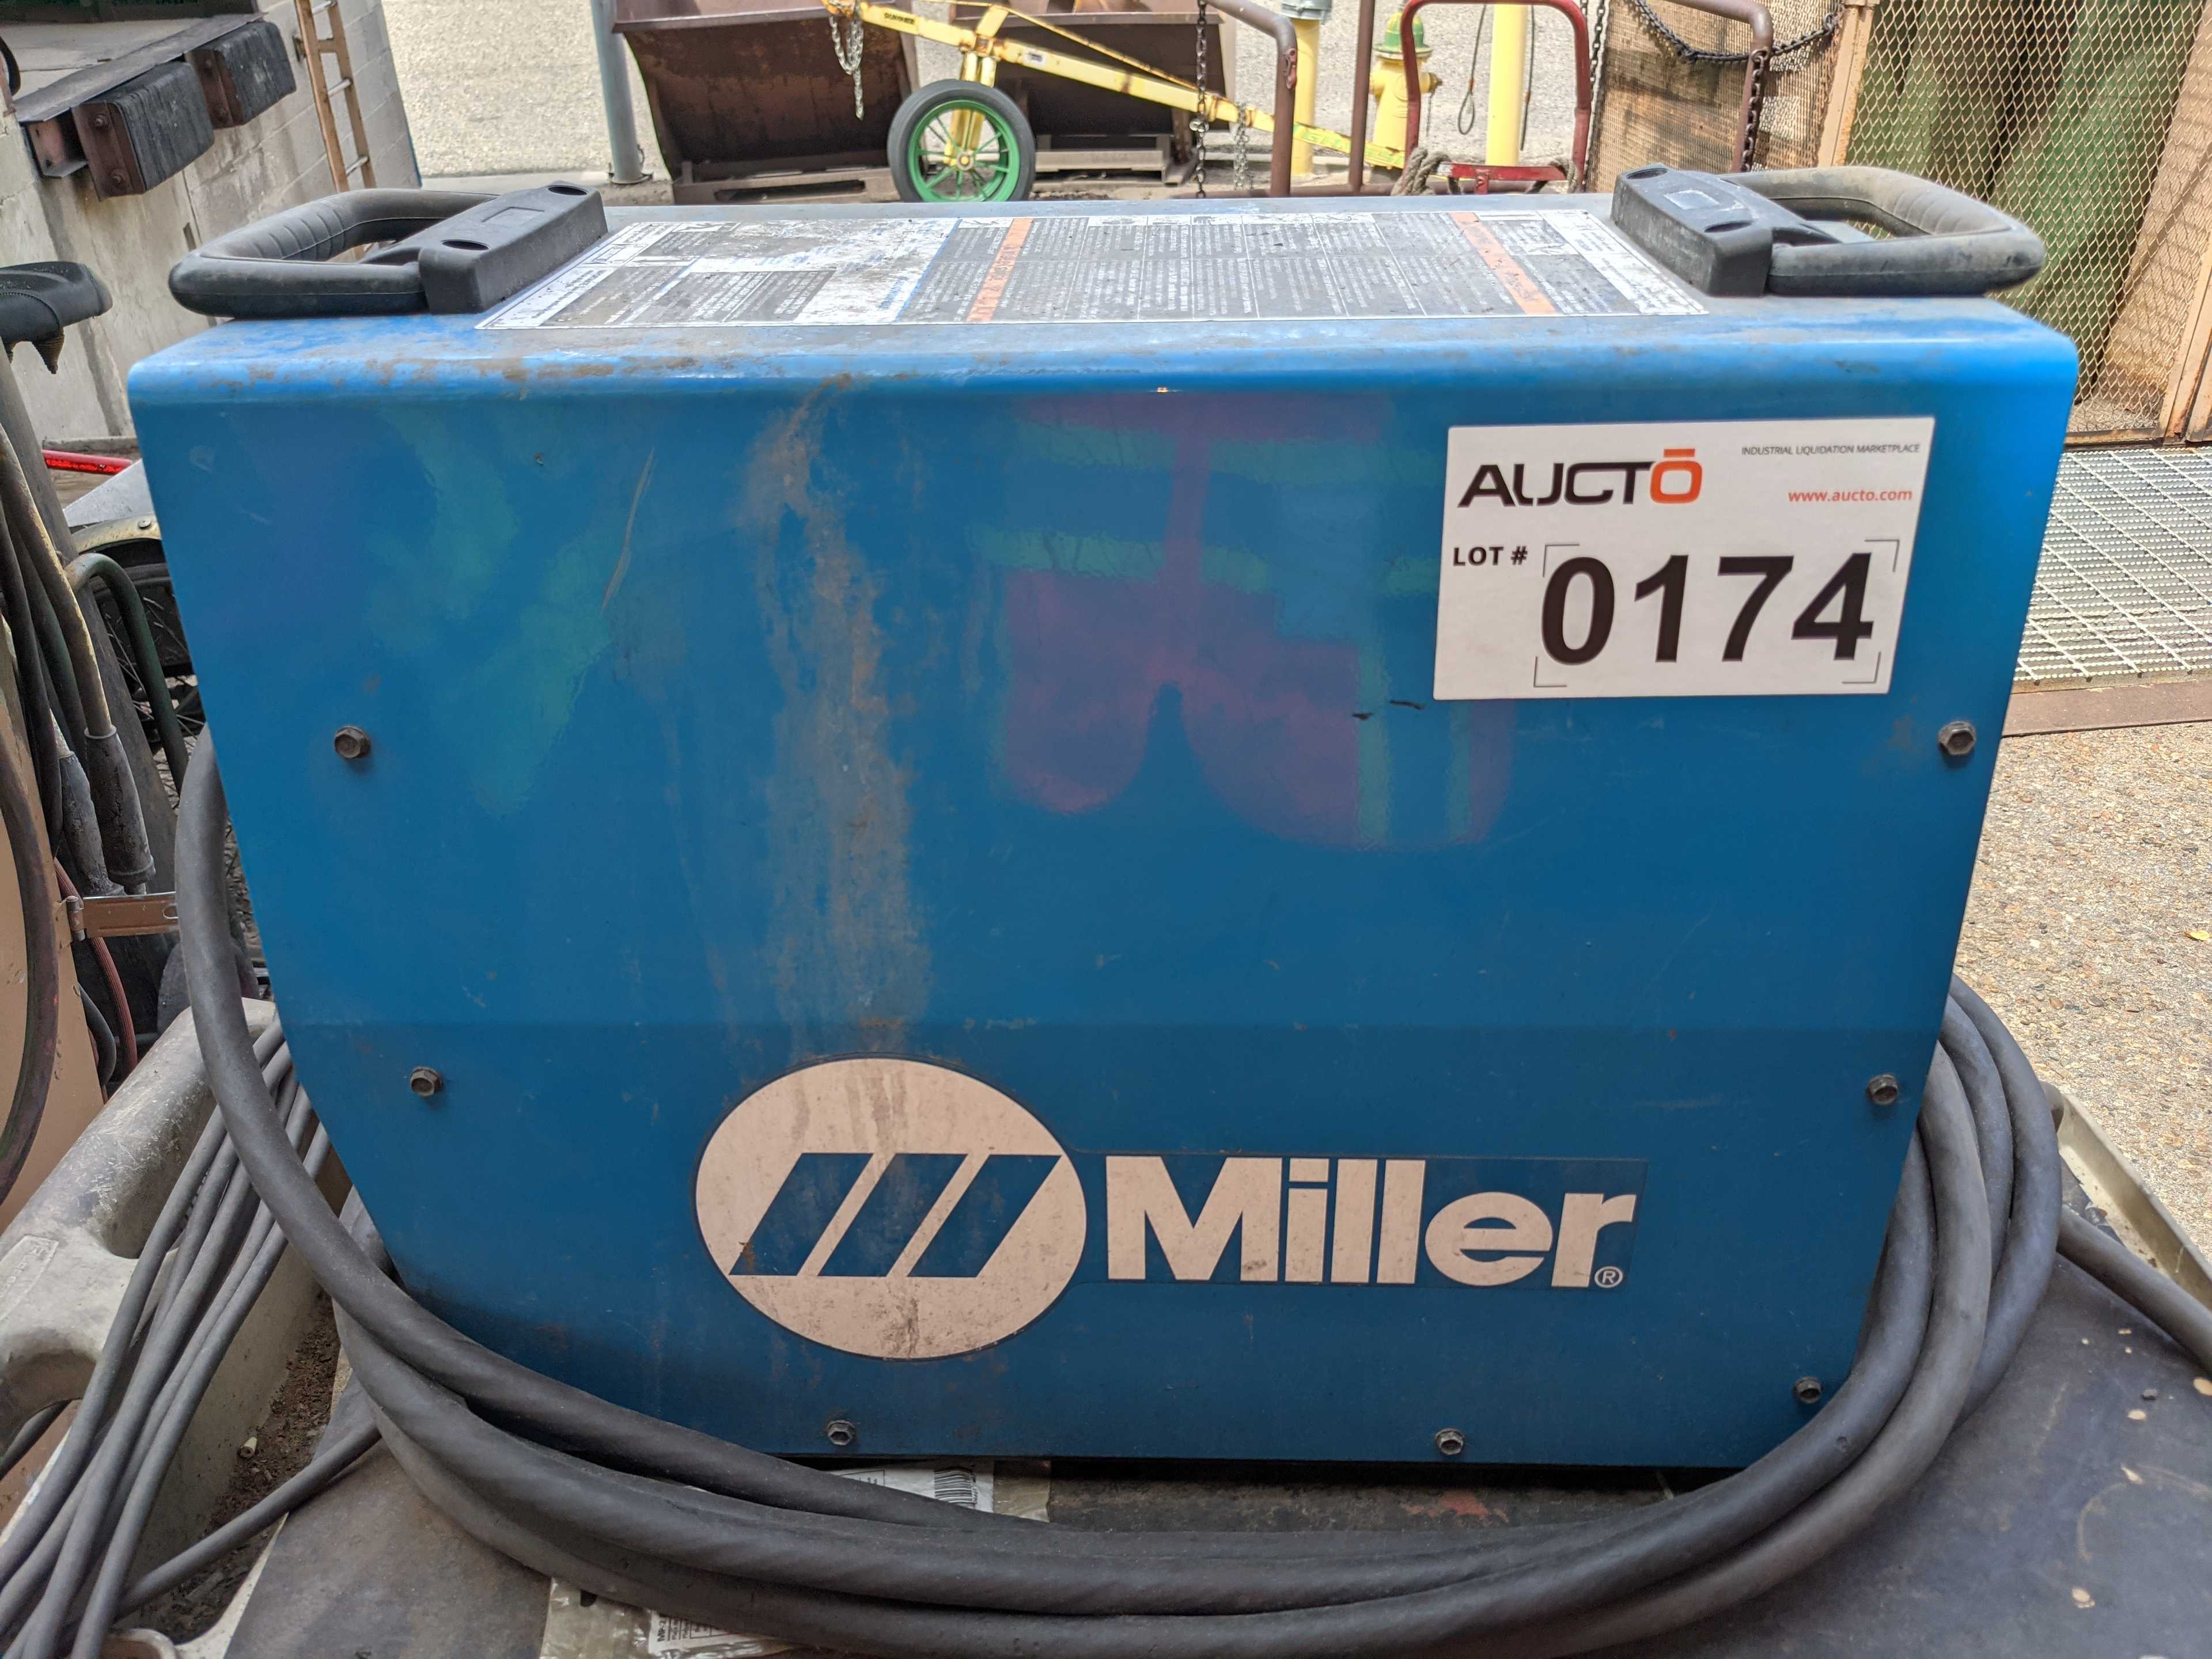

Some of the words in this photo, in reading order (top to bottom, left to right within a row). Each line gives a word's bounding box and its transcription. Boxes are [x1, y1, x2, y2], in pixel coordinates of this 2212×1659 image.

[1741, 446, 1793, 456] INDUSTRIAL
[1796, 445, 1854, 457] LIQUIDATION
[1857, 444, 1921, 454] MARKETPLACE
[1788, 490, 1912, 502] www.aucto.com
[1453, 546, 1503, 566] LOT
[1510, 546, 1528, 565] #
[1541, 553, 1875, 666] 0174
[1106, 1154, 1637, 1288] Miller
